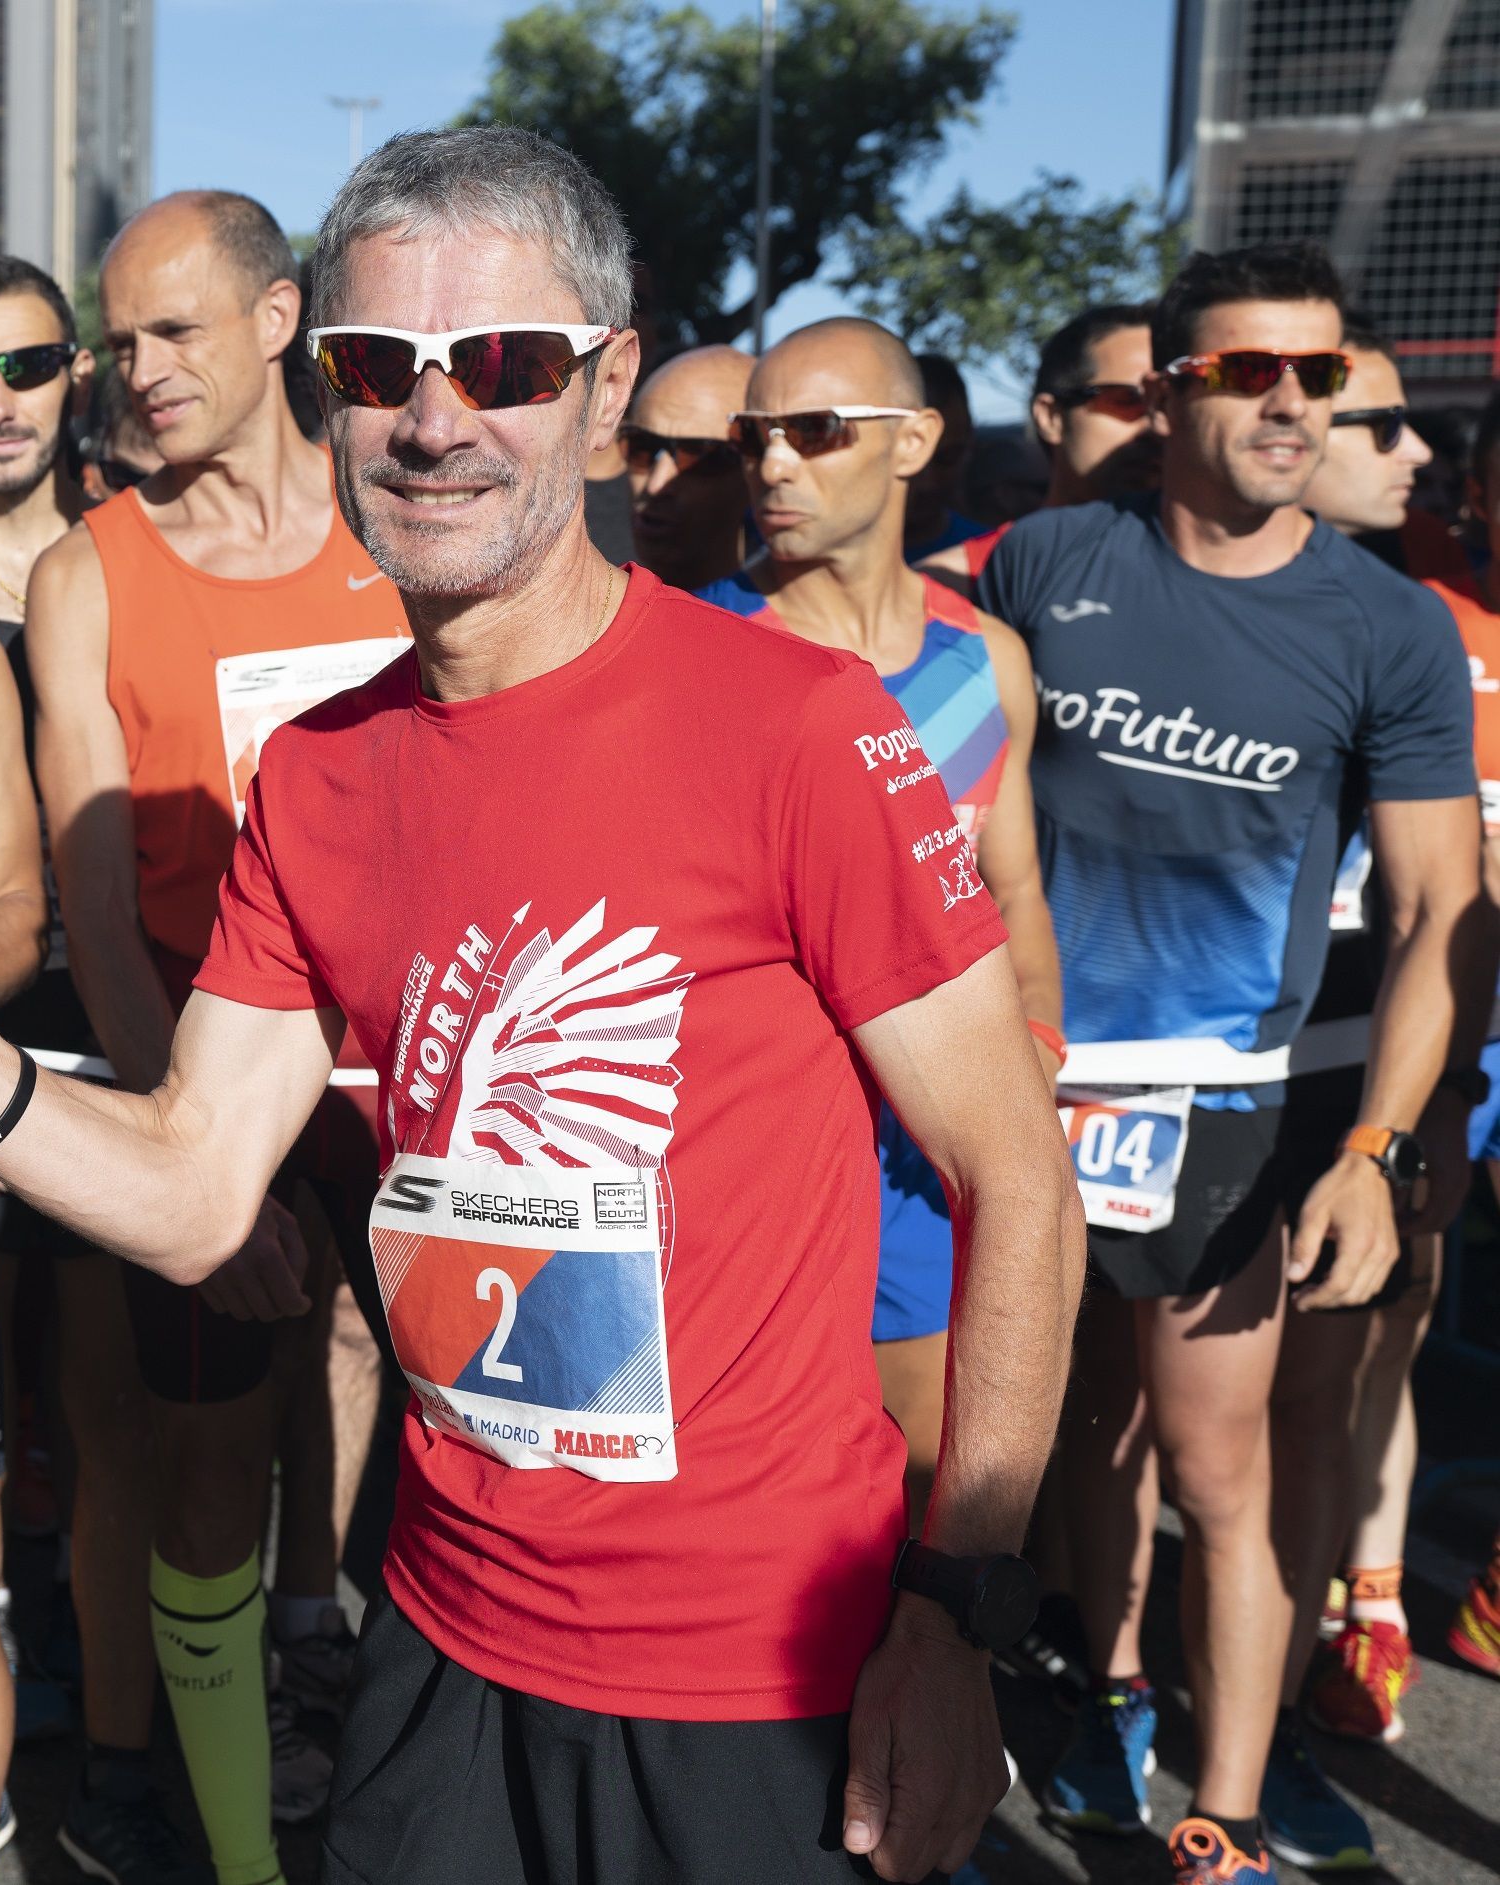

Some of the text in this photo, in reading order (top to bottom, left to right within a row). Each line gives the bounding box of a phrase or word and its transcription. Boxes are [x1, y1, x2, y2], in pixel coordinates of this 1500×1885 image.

[394, 960, 436, 1083] PERFORMANCE
[408, 923, 494, 1114] NORTH
[450, 1190, 580, 1218] SKECHERS
[597, 1188, 643, 1197] NORTH
[452, 1207, 581, 1231] PERFORMANCE
[598, 1209, 644, 1218] SOUTH
[475, 1266, 524, 1384] 2
[480, 1419, 540, 1445] MADRID
[554, 1428, 640, 1459] MARCA
